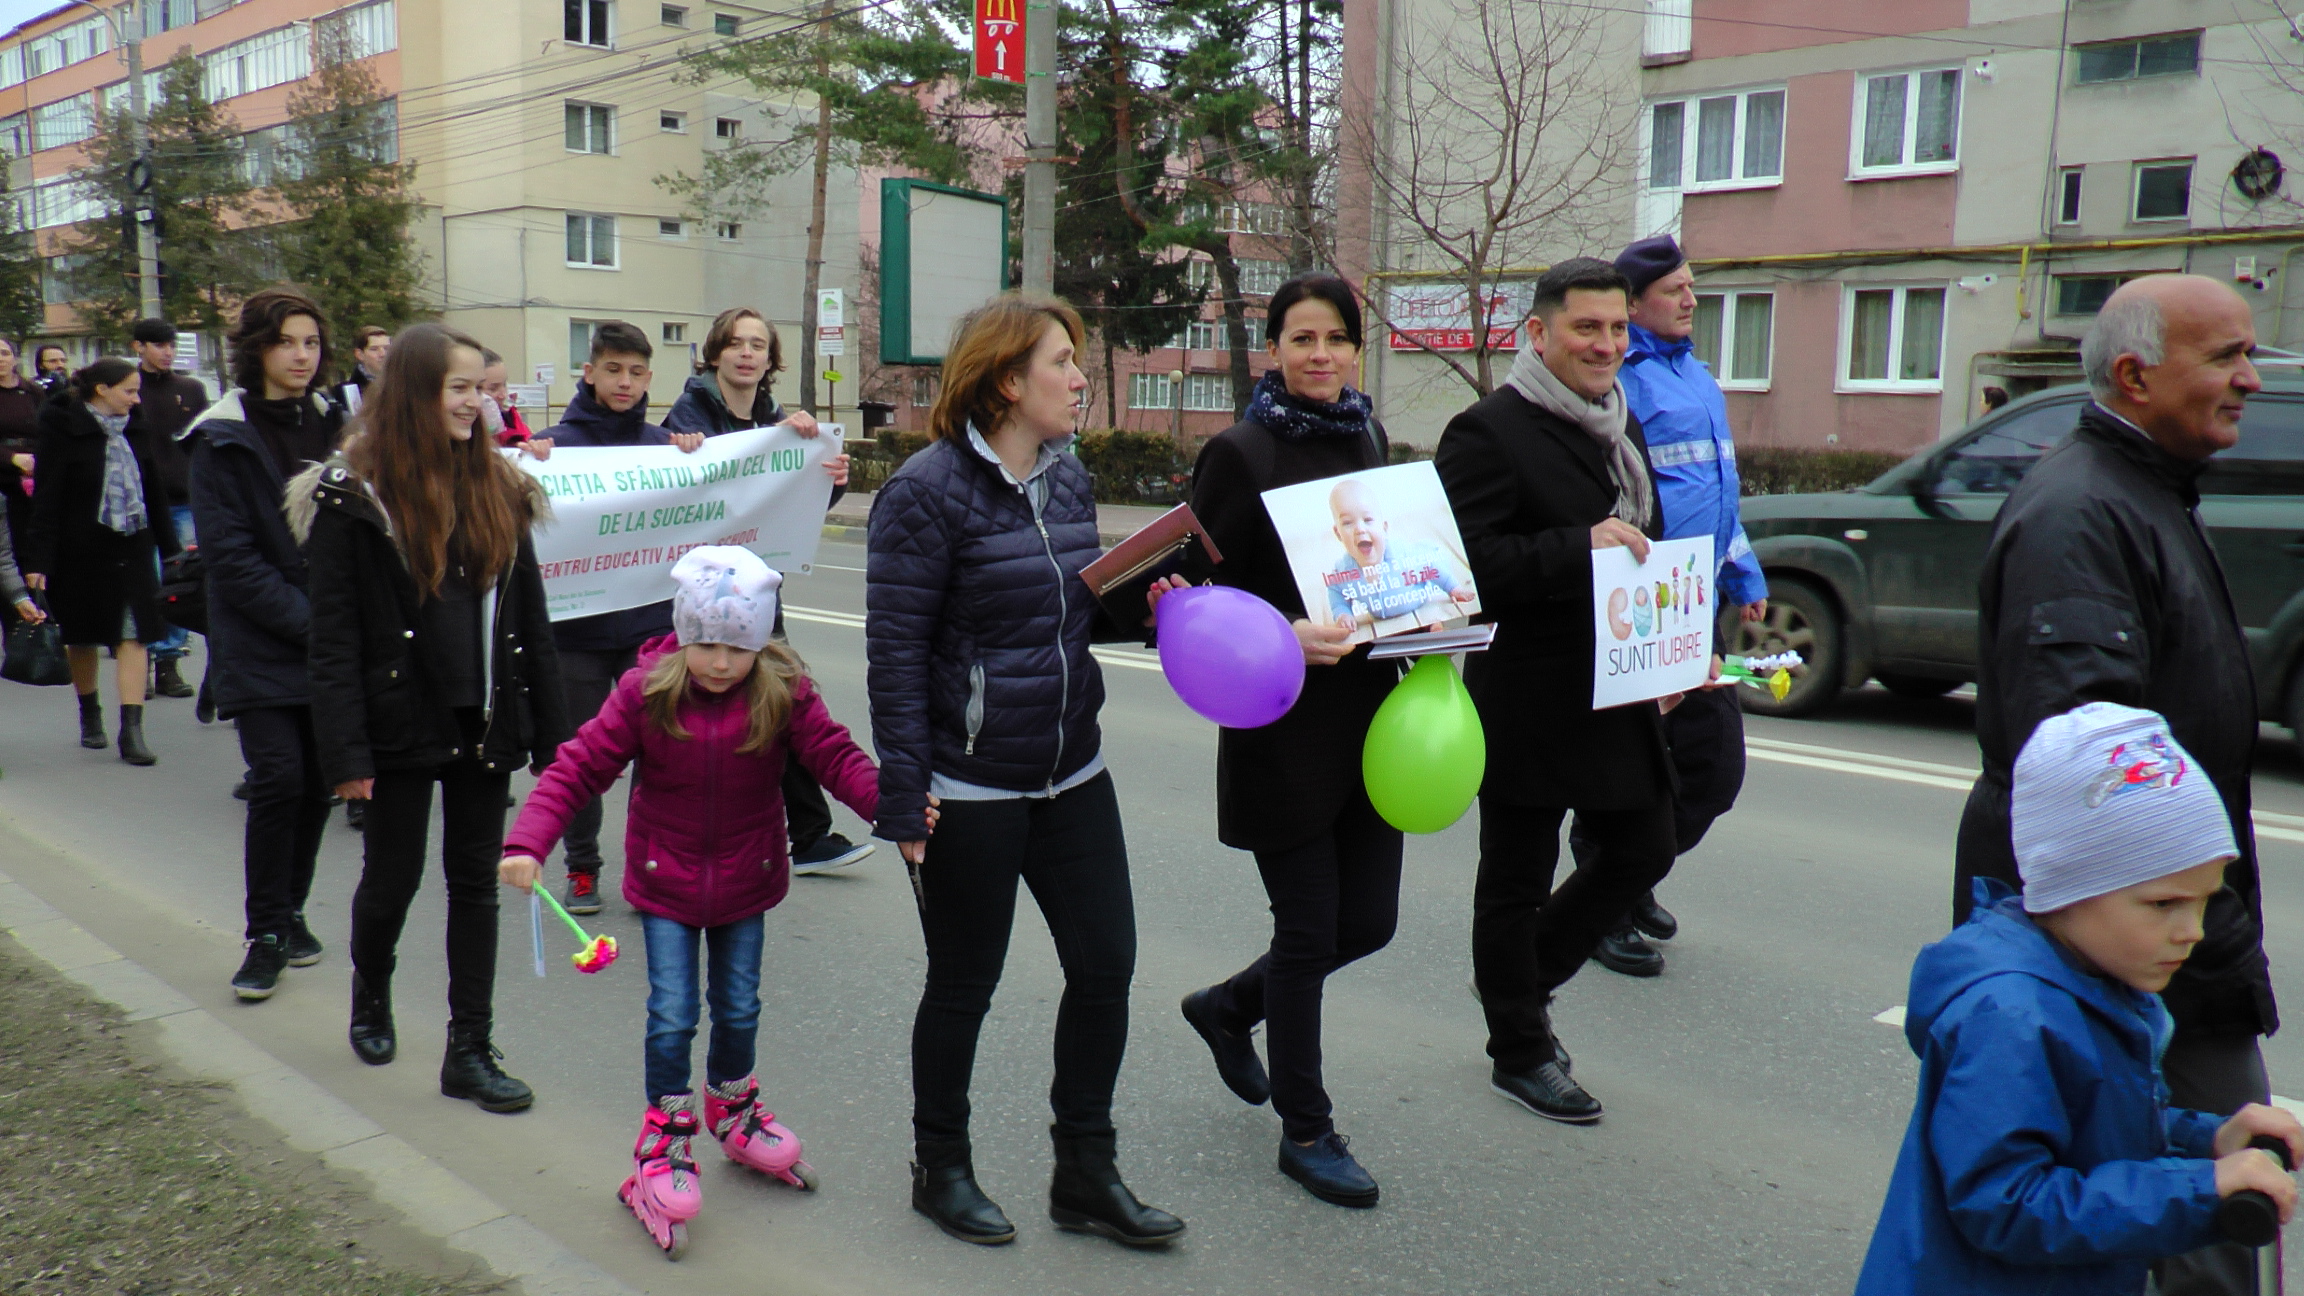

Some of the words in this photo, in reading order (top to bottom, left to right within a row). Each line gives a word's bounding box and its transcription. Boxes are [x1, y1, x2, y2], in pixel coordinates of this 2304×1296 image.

[1447, 332, 1464, 345] DE
[615, 464, 698, 492] SFÂNTUL
[701, 458, 740, 485] IOAN
[742, 453, 767, 477] CEL
[771, 447, 805, 473] NOU
[599, 512, 622, 535] DE
[625, 511, 645, 532] LA
[650, 499, 725, 529] SUCEAVA
[594, 546, 663, 572] EDUCATIV
[1322, 568, 1360, 587] Inima
[1362, 560, 1391, 578] mea
[1391, 559, 1401, 571] a
[1341, 582, 1357, 600] să
[1387, 574, 1401, 589] la
[1401, 569, 1418, 586] 16
[1419, 565, 1440, 582] zile
[1351, 599, 1369, 616] de
[1368, 595, 1383, 612] la
[1608, 642, 1656, 677] SUNT
[1658, 631, 1703, 667] IUBIRE
